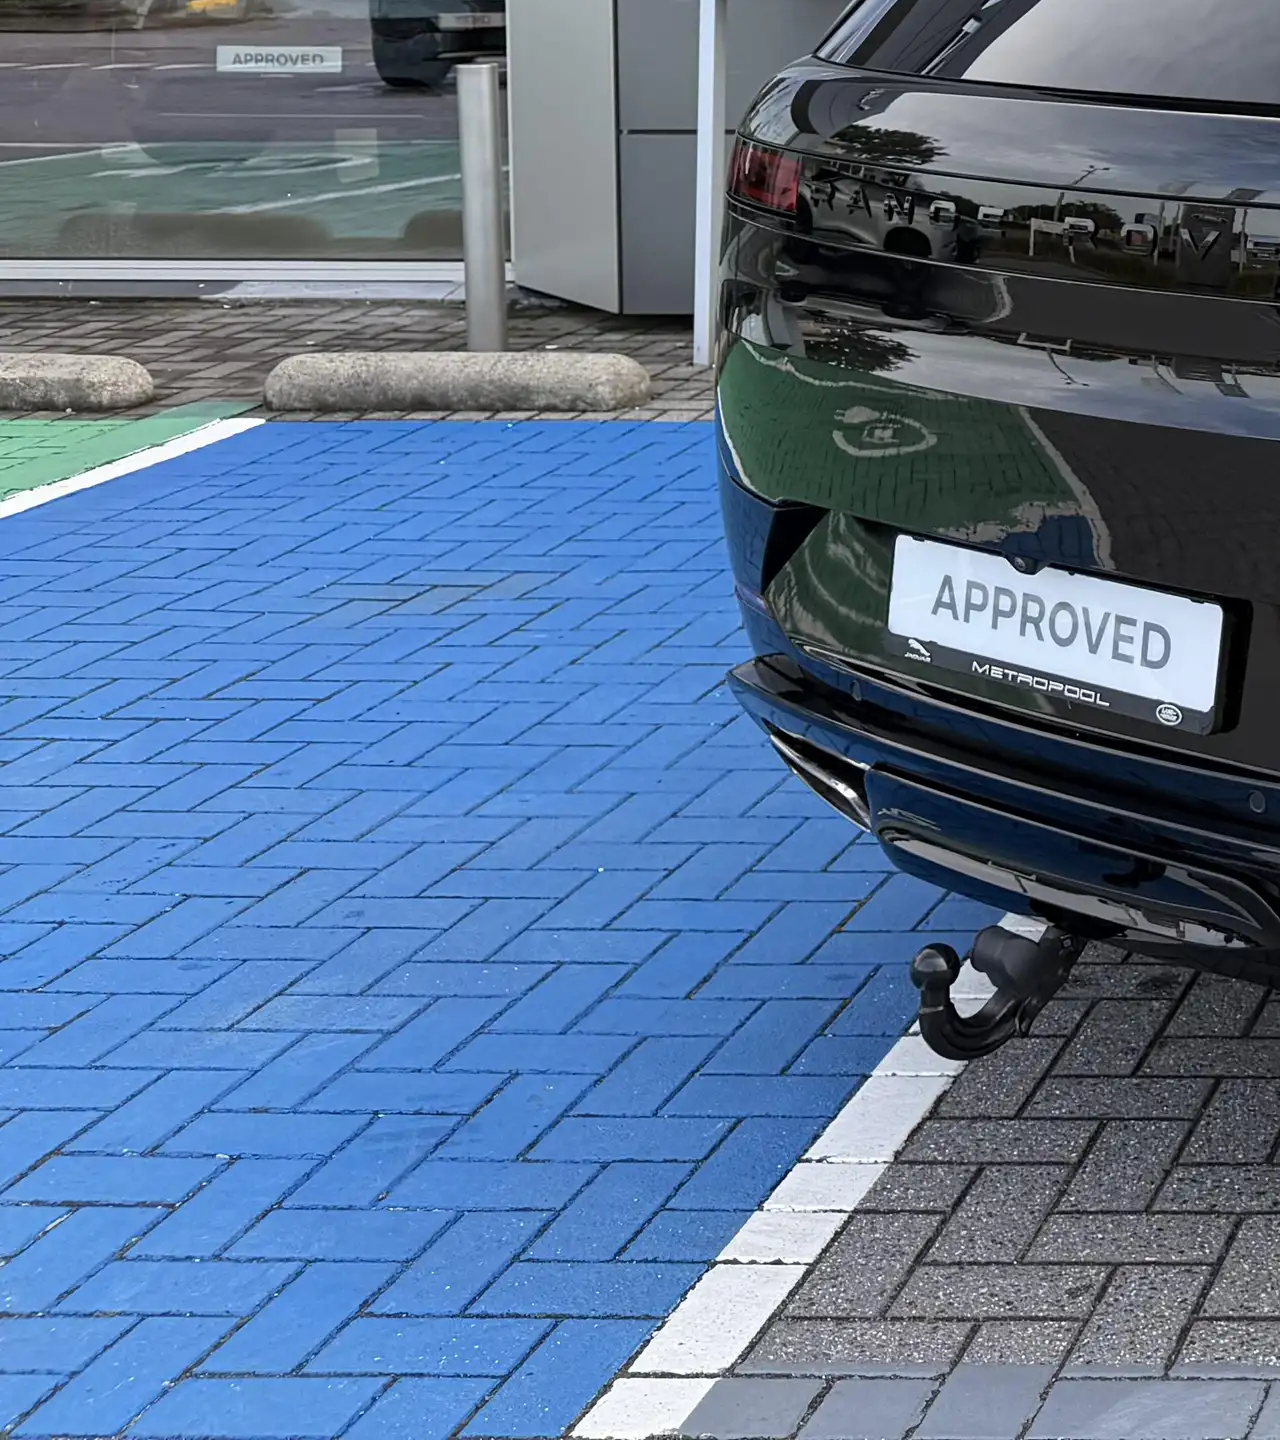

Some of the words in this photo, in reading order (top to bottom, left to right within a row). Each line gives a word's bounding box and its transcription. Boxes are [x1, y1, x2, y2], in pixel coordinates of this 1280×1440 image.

[231, 52, 325, 66] APPROVED
[930, 573, 1173, 670] APPROVED
[970, 659, 1112, 708] METROPOOL
